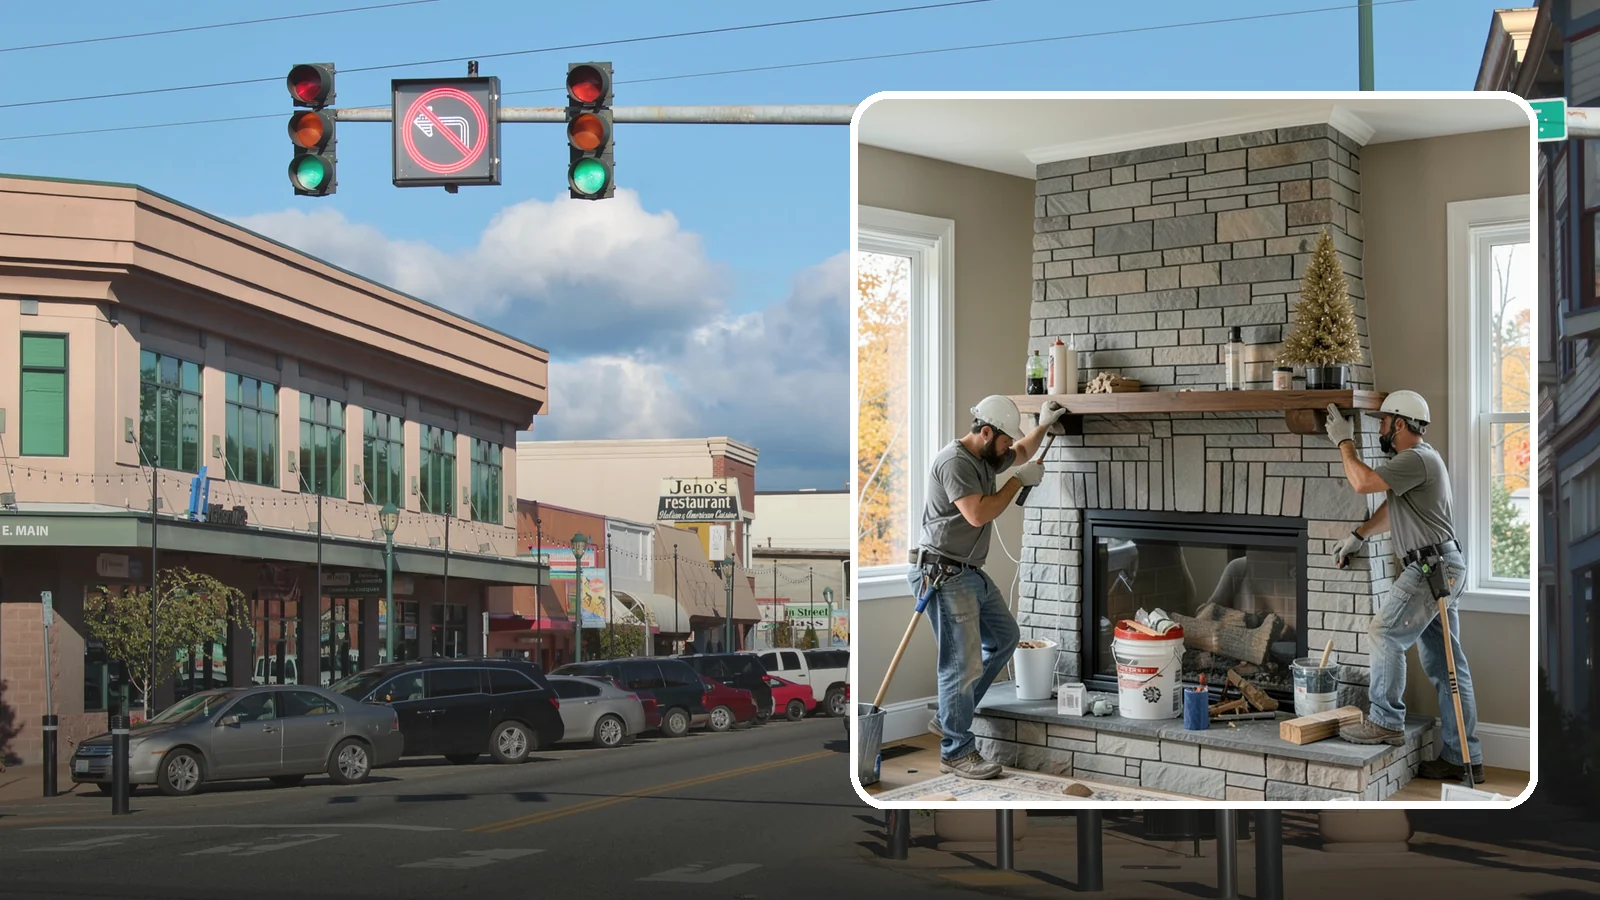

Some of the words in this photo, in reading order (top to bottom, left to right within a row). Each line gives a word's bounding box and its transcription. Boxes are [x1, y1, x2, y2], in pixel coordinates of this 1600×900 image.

[669, 480, 728, 494] Jeno's
[665, 496, 731, 509] restaurant
[658, 510, 681, 520] Italian
[686, 510, 714, 519] American
[715, 509, 738, 519] Cuisine
[2, 525, 13, 536] E.
[15, 525, 49, 536] MAIN
[785, 607, 795, 616] in
[797, 608, 828, 616] Street
